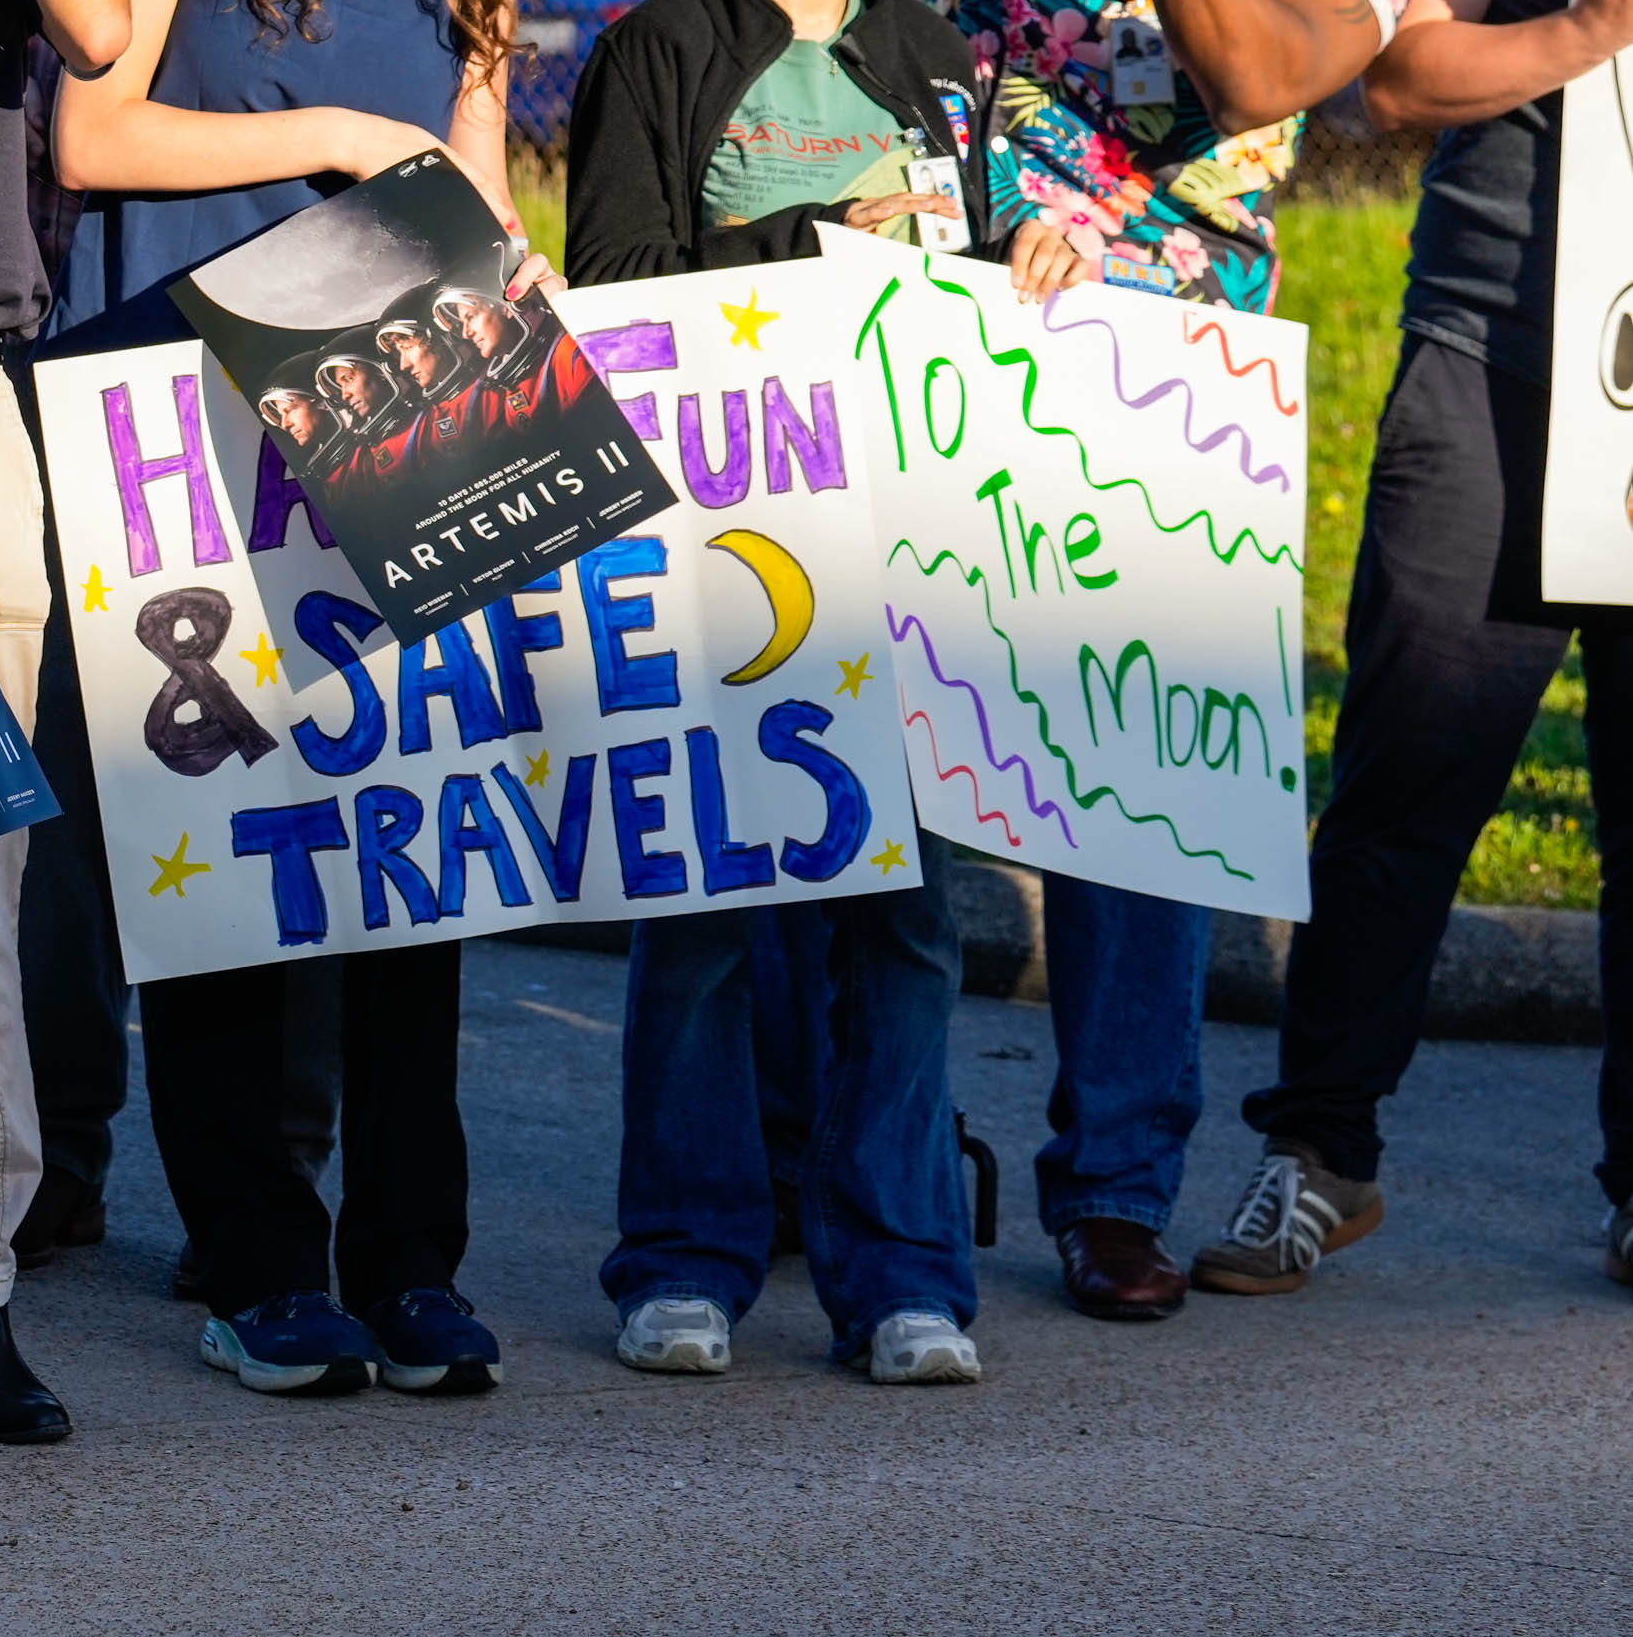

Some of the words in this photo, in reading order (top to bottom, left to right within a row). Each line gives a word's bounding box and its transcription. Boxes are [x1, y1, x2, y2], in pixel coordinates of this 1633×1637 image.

[725, 122, 862, 156] SATURN
[867, 133, 891, 153] V
[384, 468, 584, 588] ARTEMIS
[596, 441, 630, 474] II
[415, 511, 448, 530] AROUND
[447, 502, 464, 513] THE
[464, 491, 488, 505] MOON
[488, 481, 507, 493] FOR
[507, 473, 522, 484] ALL
[521, 450, 561, 475] HUMANITY
[448, 489, 468, 503] DAYS
[503, 457, 528, 474] MILES
[976, 468, 1119, 599] The
[230, 698, 873, 947] TRAVELS
